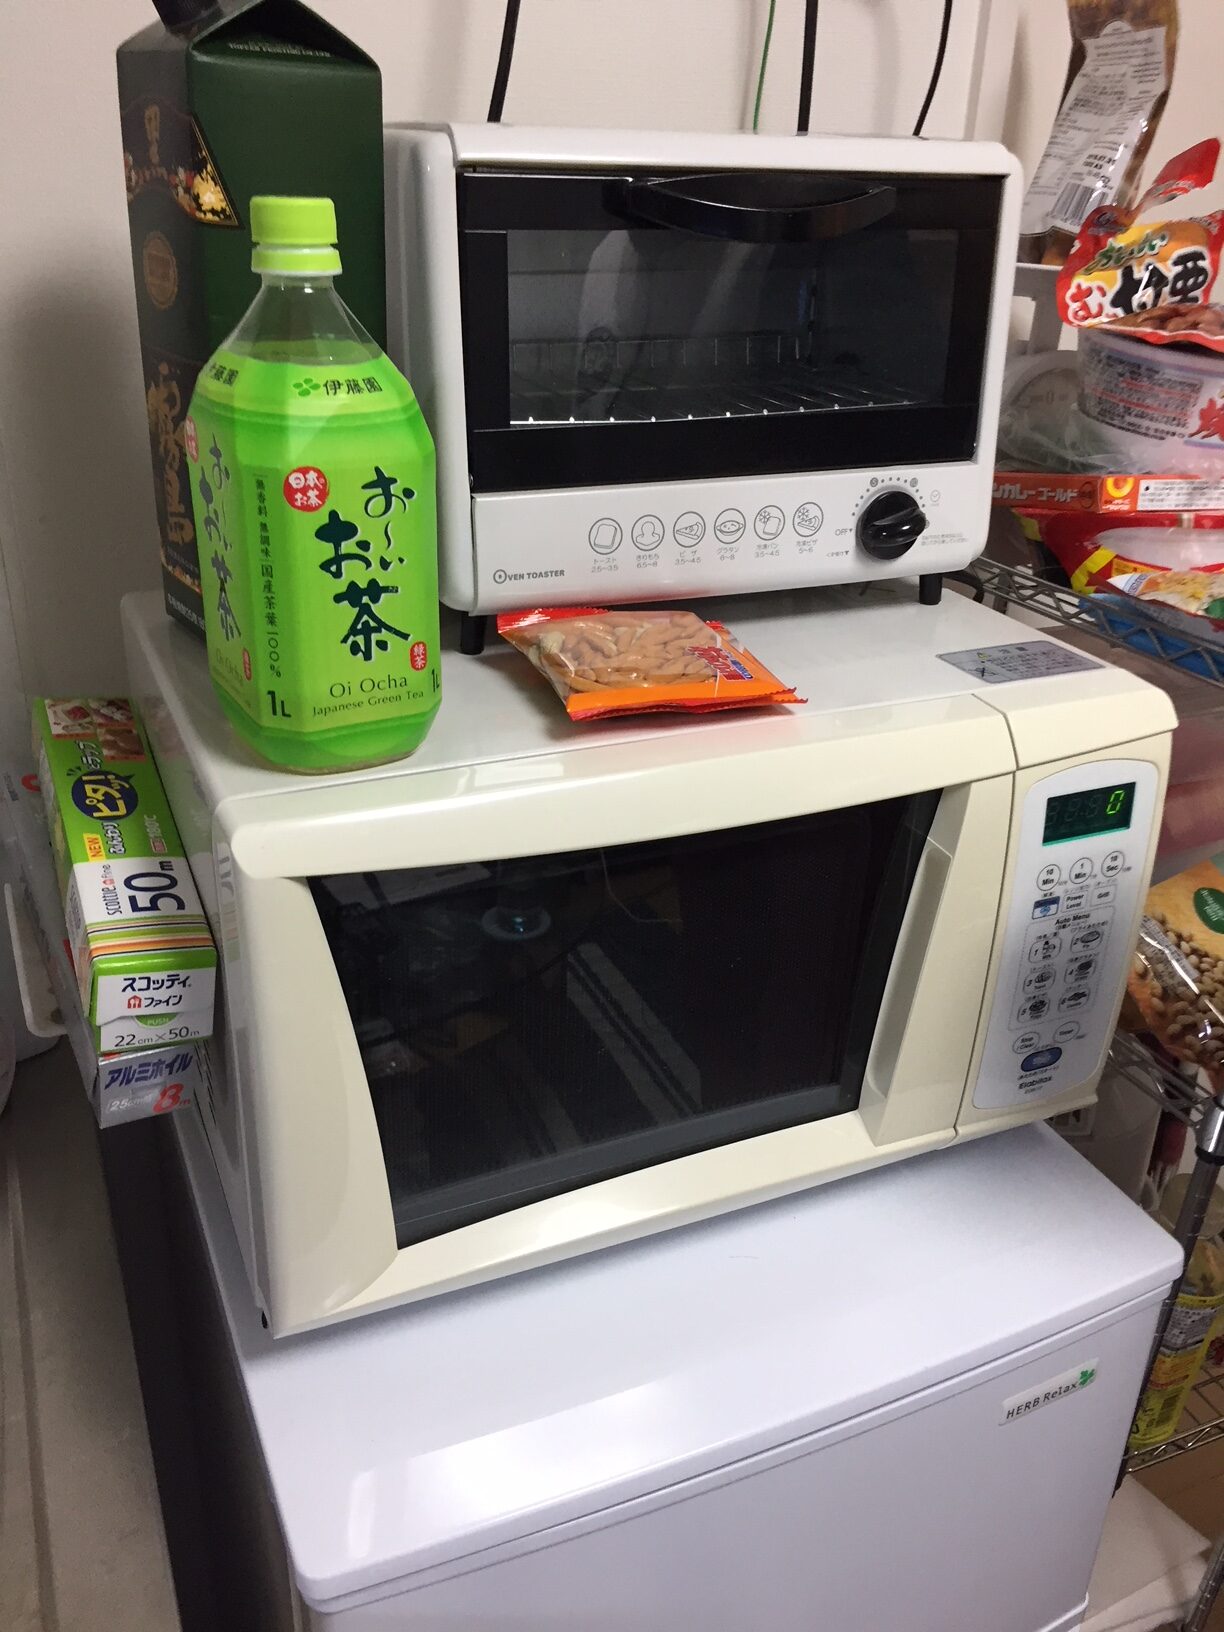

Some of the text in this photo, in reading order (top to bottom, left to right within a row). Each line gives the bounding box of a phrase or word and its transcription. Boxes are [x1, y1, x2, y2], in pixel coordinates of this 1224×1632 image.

[323, 376, 383, 397] 伊藤園
[526, 569, 565, 579] TOASTER
[329, 674, 408, 698] Oi Ocha
[267, 690, 292, 718] 1L
[313, 690, 424, 717] Japanese Green Tea
[1106, 790, 1124, 815] 0
[86, 836, 103, 858] NEW
[121, 974, 191, 993] スコッティ
[143, 994, 182, 1008] ファイン
[147, 1016, 170, 1027] PUSH
[104, 1052, 193, 1090] アルミホイル
[1006, 1381, 1078, 1419] HERB Relax
